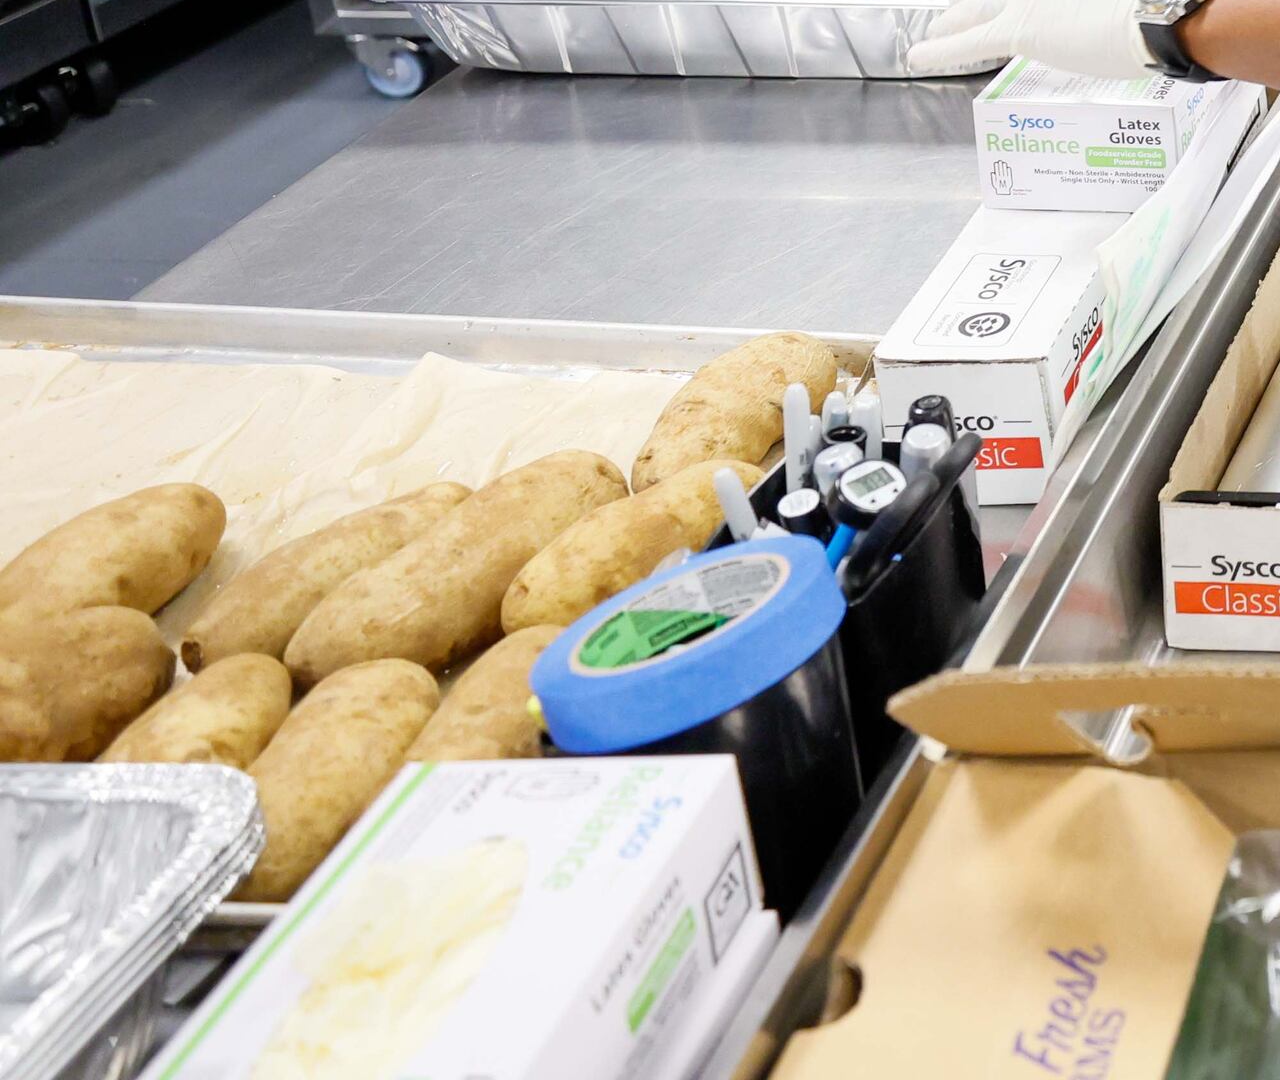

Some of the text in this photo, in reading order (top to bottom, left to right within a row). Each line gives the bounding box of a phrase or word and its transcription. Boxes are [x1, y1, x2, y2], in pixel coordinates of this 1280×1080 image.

[1152, 79, 1175, 101] oves
[1008, 113, 1054, 131] Sysco
[1118, 118, 1160, 131] Latex
[985, 132, 1080, 154] Reliance
[1109, 132, 1162, 145] Gloves
[1034, 168, 1064, 176] Medium
[1114, 170, 1165, 179] Ambidextrous
[1060, 176, 1083, 185] Single
[1099, 177, 1115, 186] Only
[1140, 179, 1165, 187] Length
[977, 259, 1027, 300] Sysco
[1072, 306, 1099, 362] Sysco
[953, 415, 995, 432] sco
[1012, 943, 1108, 1076] Fresh
